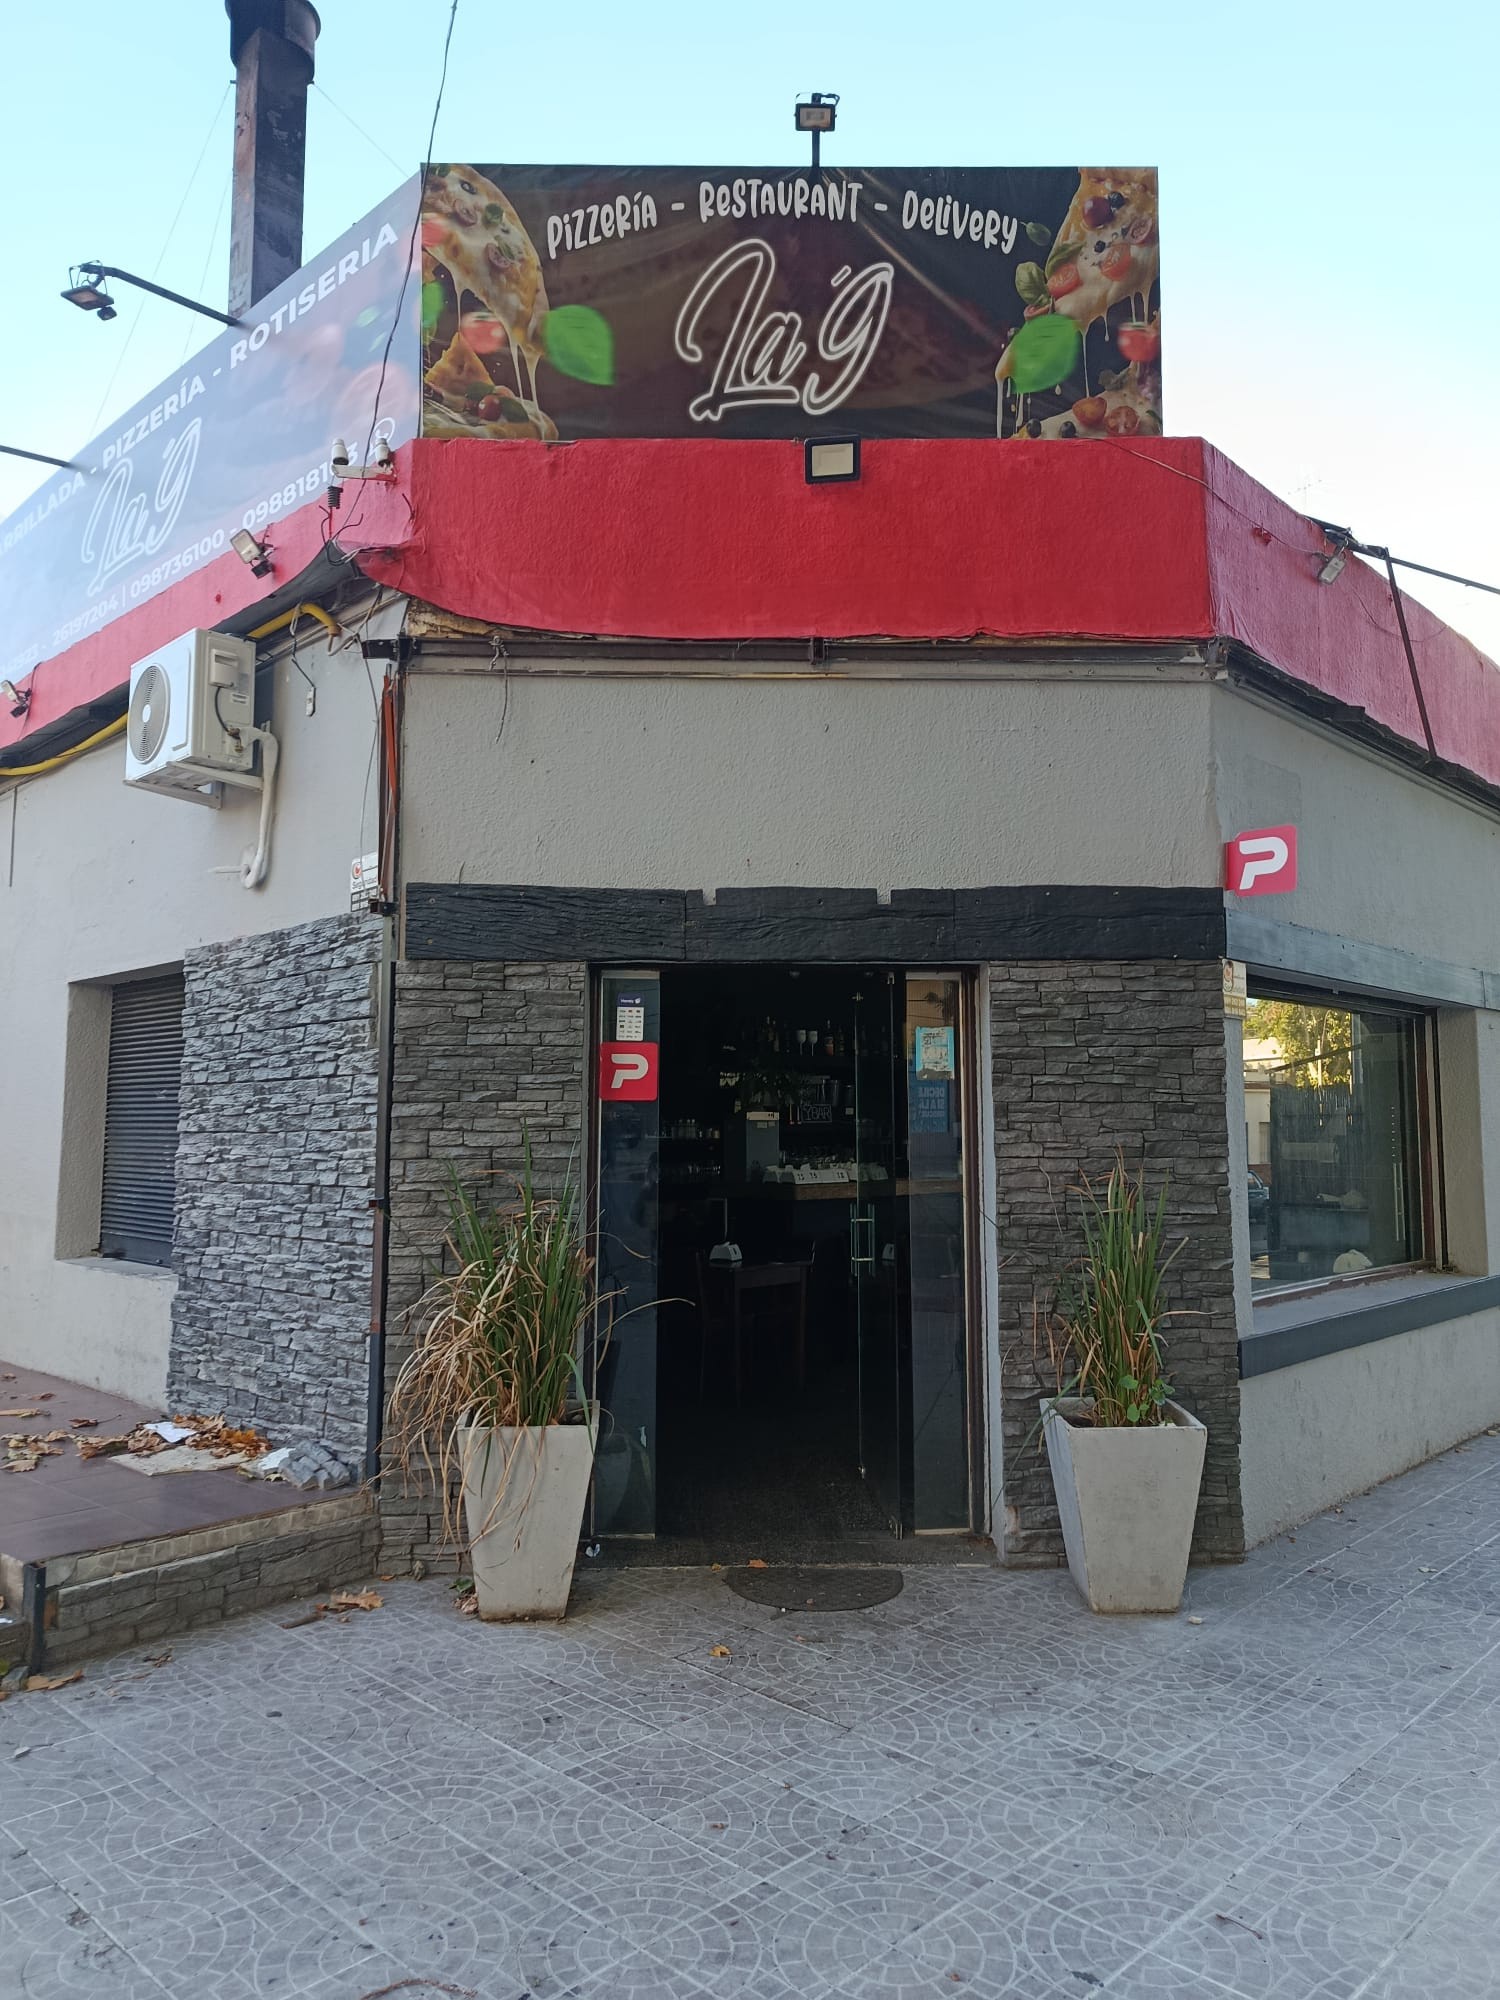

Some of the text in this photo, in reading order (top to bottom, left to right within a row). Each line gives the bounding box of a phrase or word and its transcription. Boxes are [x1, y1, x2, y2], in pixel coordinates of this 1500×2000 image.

[0, 471, 86, 556] RRILLADA
[102, 375, 206, 470] PIZZERÍA
[230, 222, 399, 369] ROTISERIA
[130, 528, 226, 598] 098736100
[242, 442, 358, 532] 09881813
